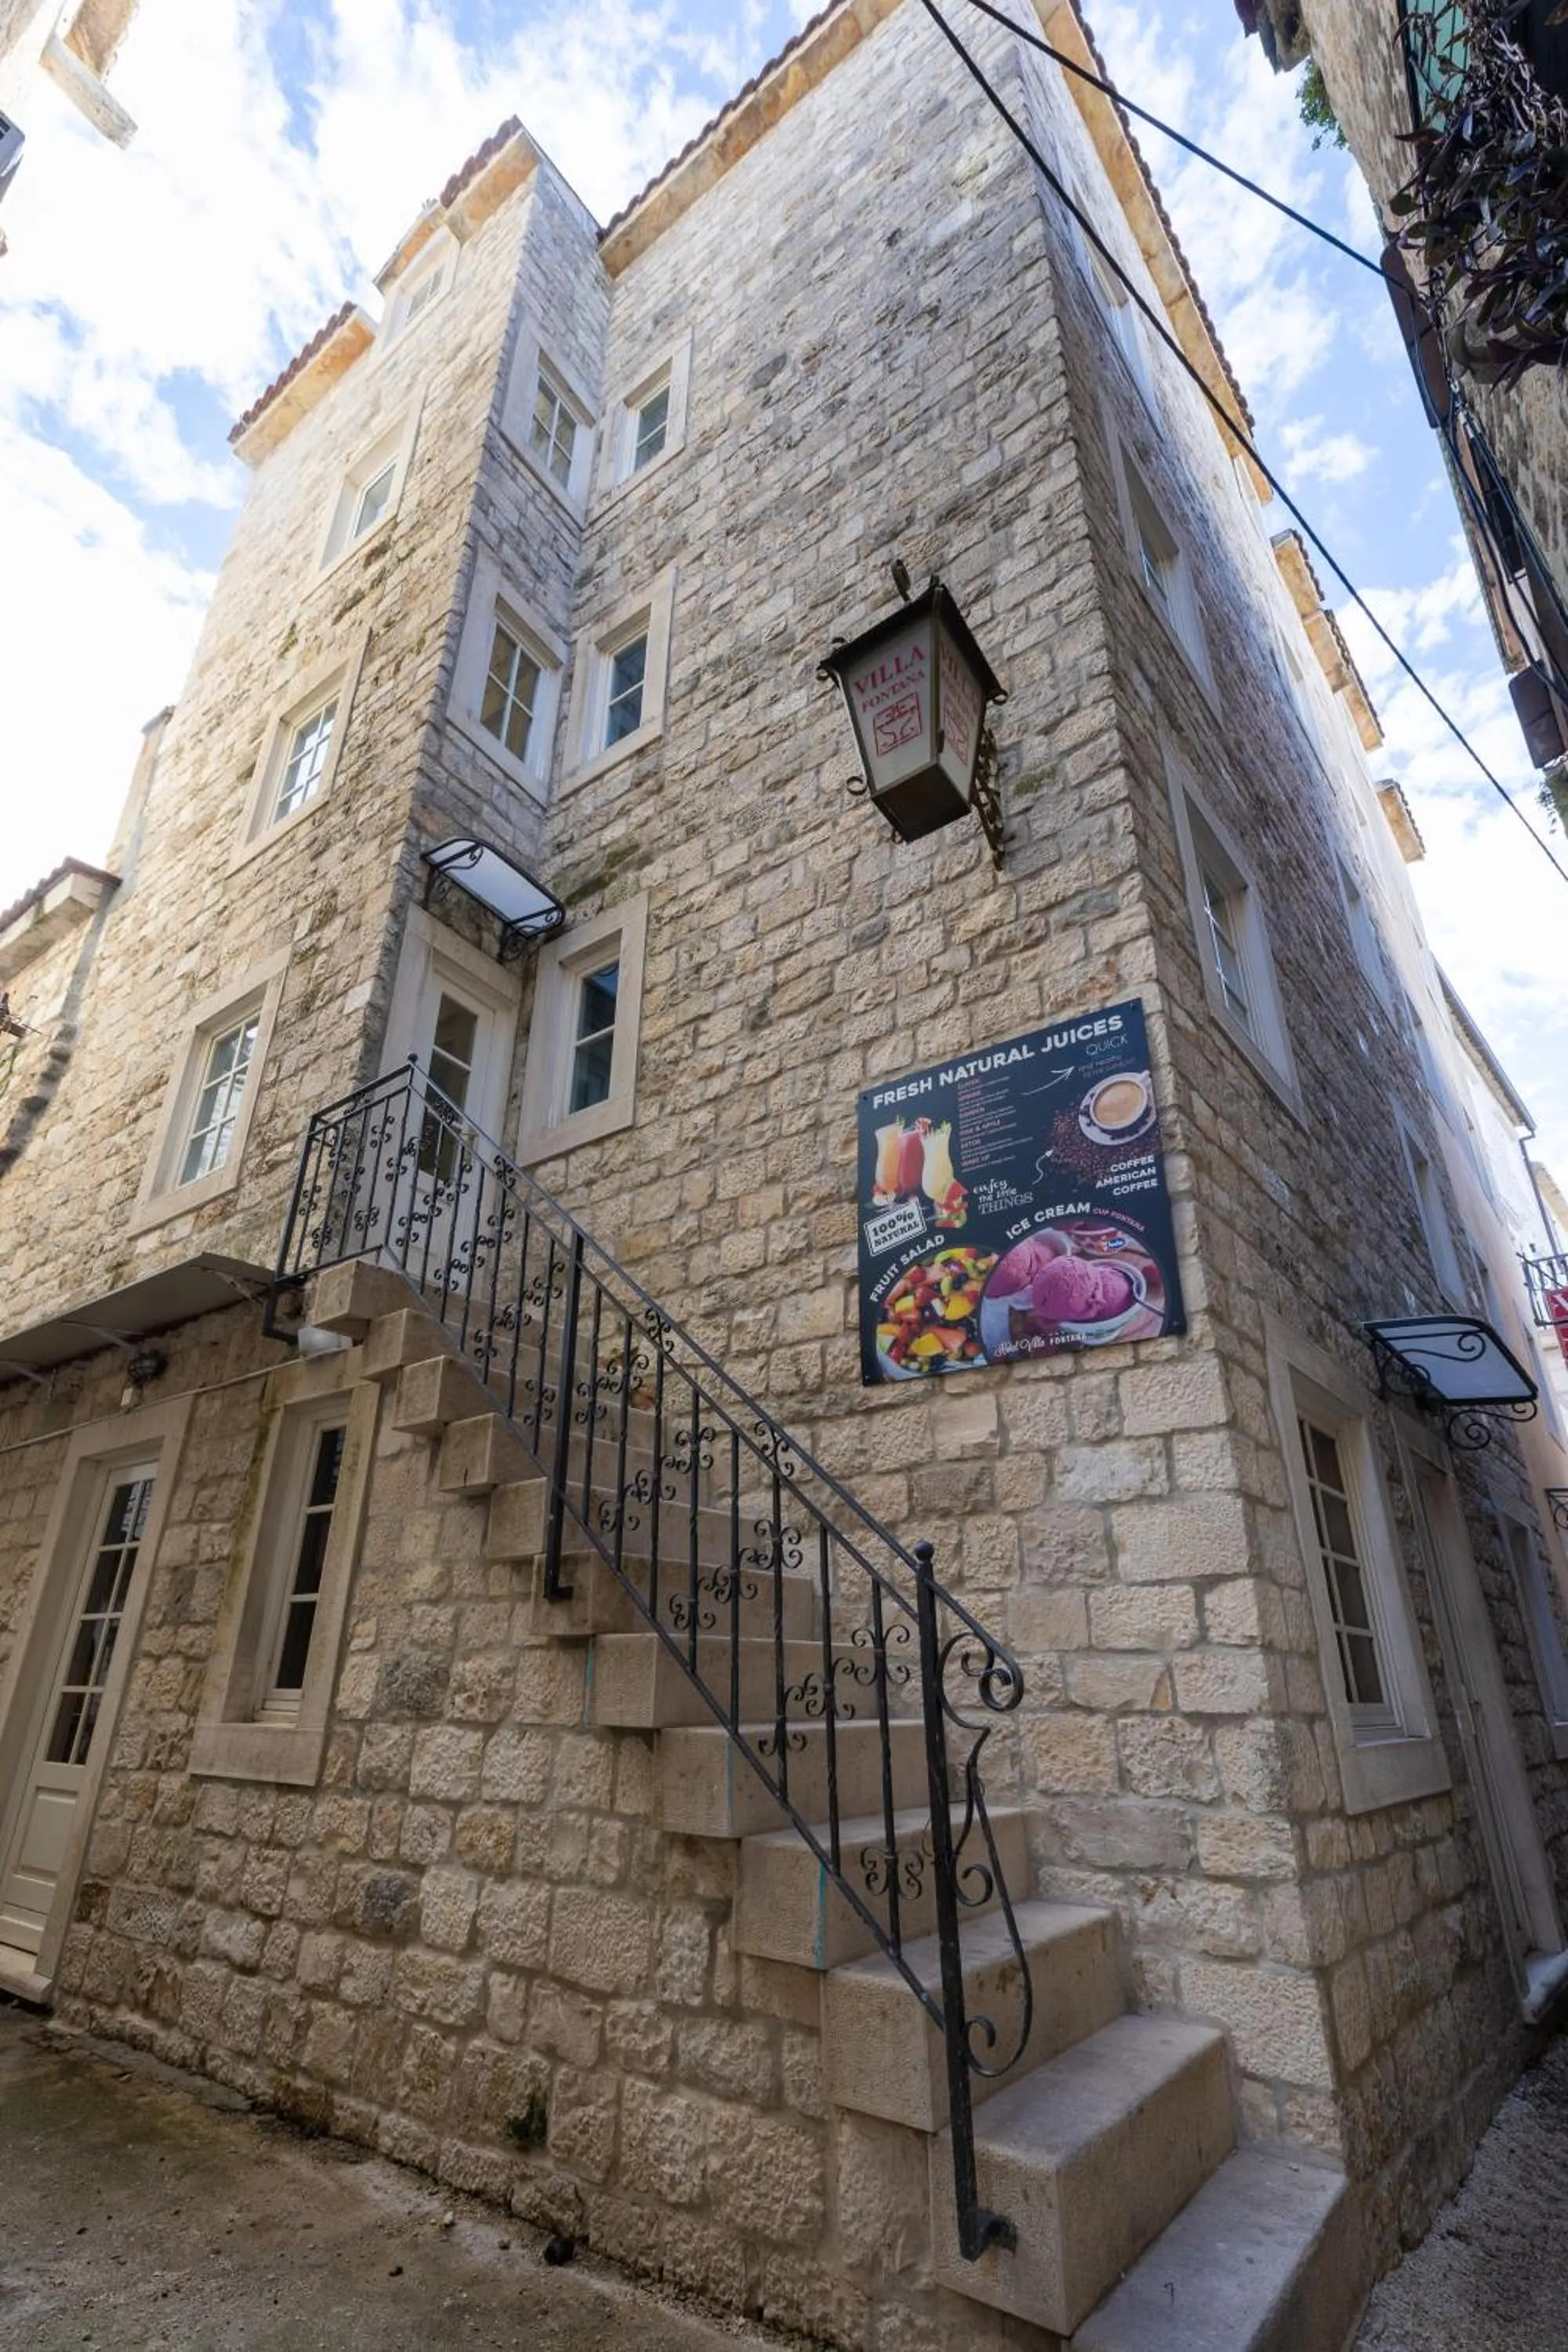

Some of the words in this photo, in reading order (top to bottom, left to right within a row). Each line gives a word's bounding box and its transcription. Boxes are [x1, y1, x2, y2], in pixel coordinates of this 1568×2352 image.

[855, 645, 924, 694] VILLA
[873, 1076, 933, 1109] FRESH
[939, 1044, 1036, 1087] NATURAL
[1040, 1014, 1123, 1052] JUICES
[1110, 1155, 1155, 1173] COFFEE
[1095, 1167, 1156, 1189] AMERICAN
[1112, 1178, 1158, 1196] COFFEE
[978, 1192, 1033, 1214] THINGS
[872, 1209, 915, 1237] 100%
[873, 1221, 920, 1247] NATURAL
[1006, 1218, 1031, 1240] ICE
[1034, 1202, 1091, 1222] CREAM
[869, 1266, 899, 1302] FRUIT
[901, 1235, 945, 1264] SALAD
